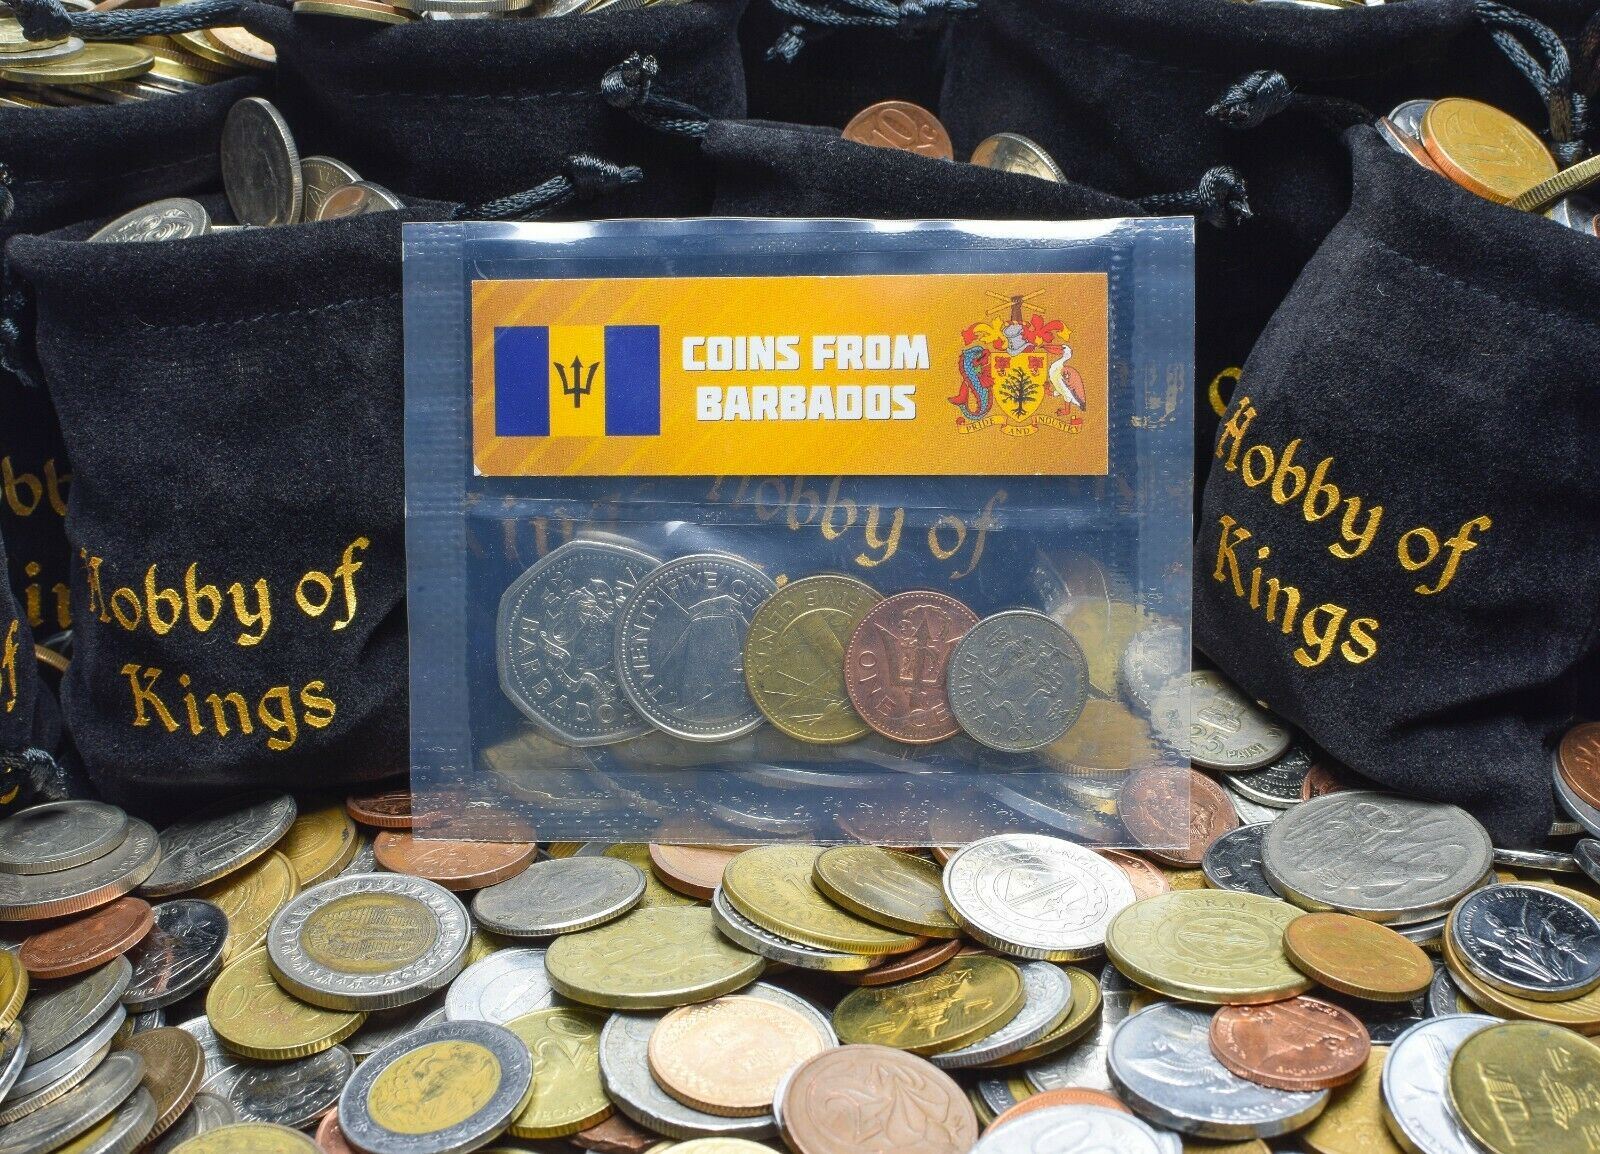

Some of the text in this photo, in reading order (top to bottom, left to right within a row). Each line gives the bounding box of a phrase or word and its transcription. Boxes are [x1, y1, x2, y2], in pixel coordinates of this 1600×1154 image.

[682, 334, 930, 371] COINS FROM
[696, 385, 917, 421] BARBADOS
[966, 416, 994, 433] PRIDE
[1215, 396, 1383, 558] Hobby
[1397, 515, 1492, 595] of
[80, 548, 273, 646] Hobby
[295, 537, 370, 631] of
[1213, 515, 1380, 668] Kings
[121, 664, 336, 751] Kings
